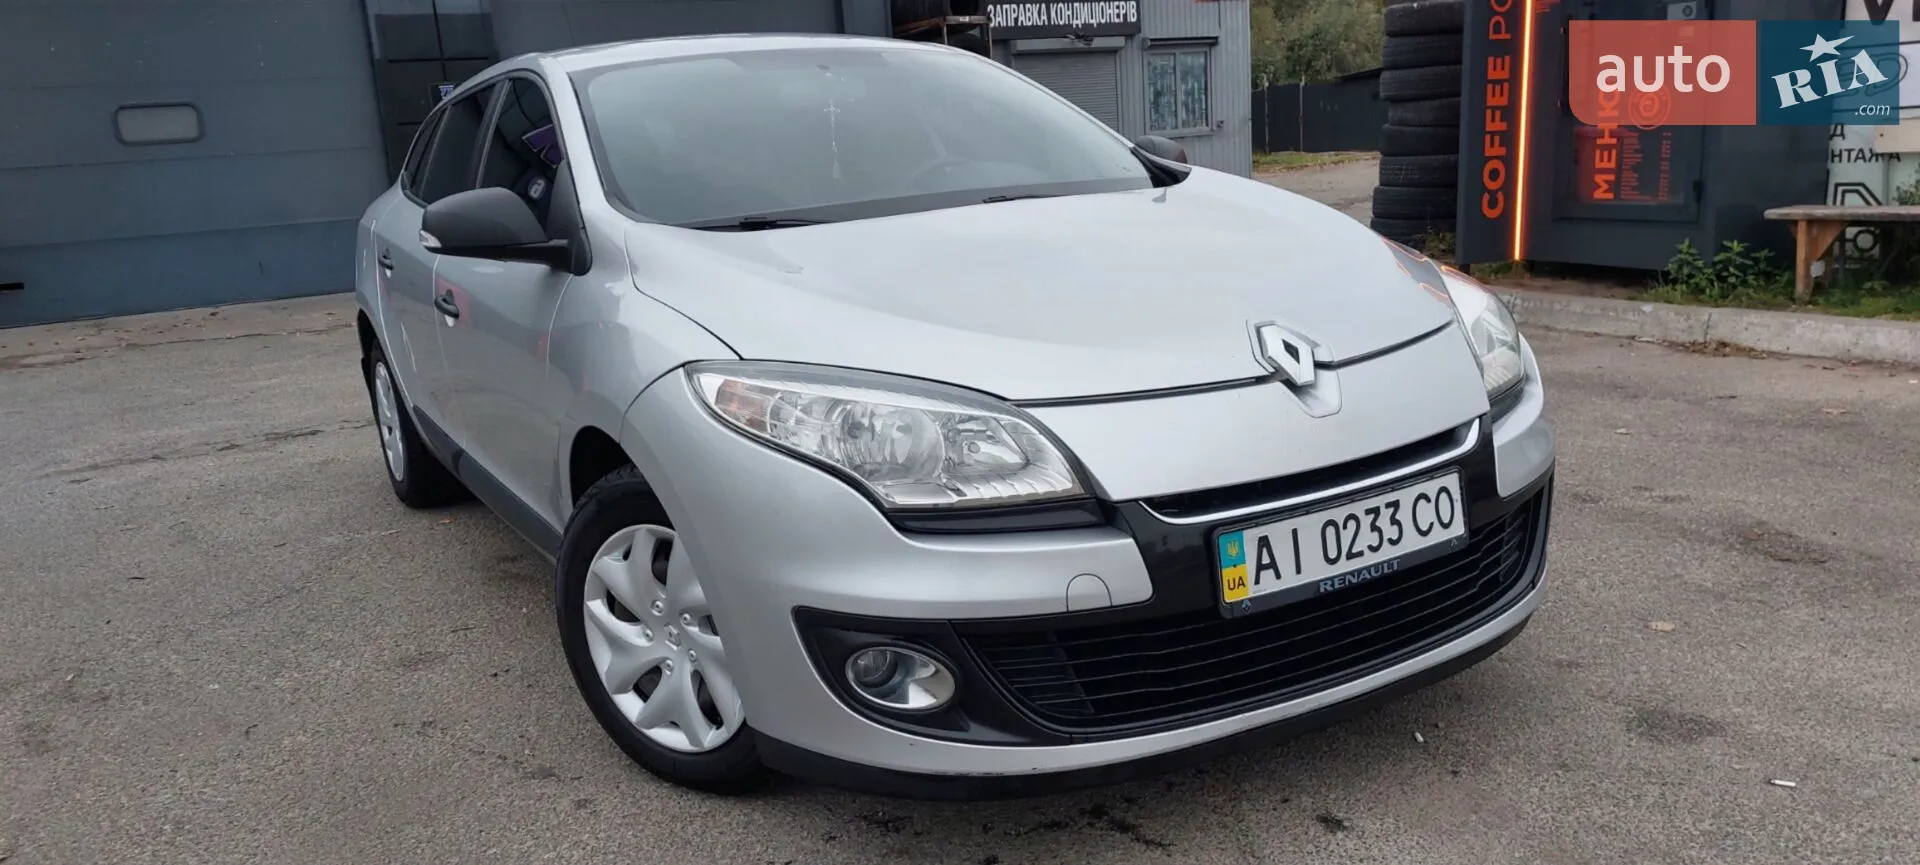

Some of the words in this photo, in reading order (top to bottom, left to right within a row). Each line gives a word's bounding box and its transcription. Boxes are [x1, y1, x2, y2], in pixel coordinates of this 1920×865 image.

[987, 4, 1048, 28] ЗАПРАВКА
[1050, 1, 1138, 26] КОНДИЦІОНЕРІВ
[1480, 55, 1511, 220] COFFEE
[1254, 527, 1302, 586] AI
[1320, 499, 1404, 566] 0233
[1411, 485, 1455, 537] CO
[1227, 578, 1246, 592] UA
[1319, 558, 1401, 593] RENAULT
